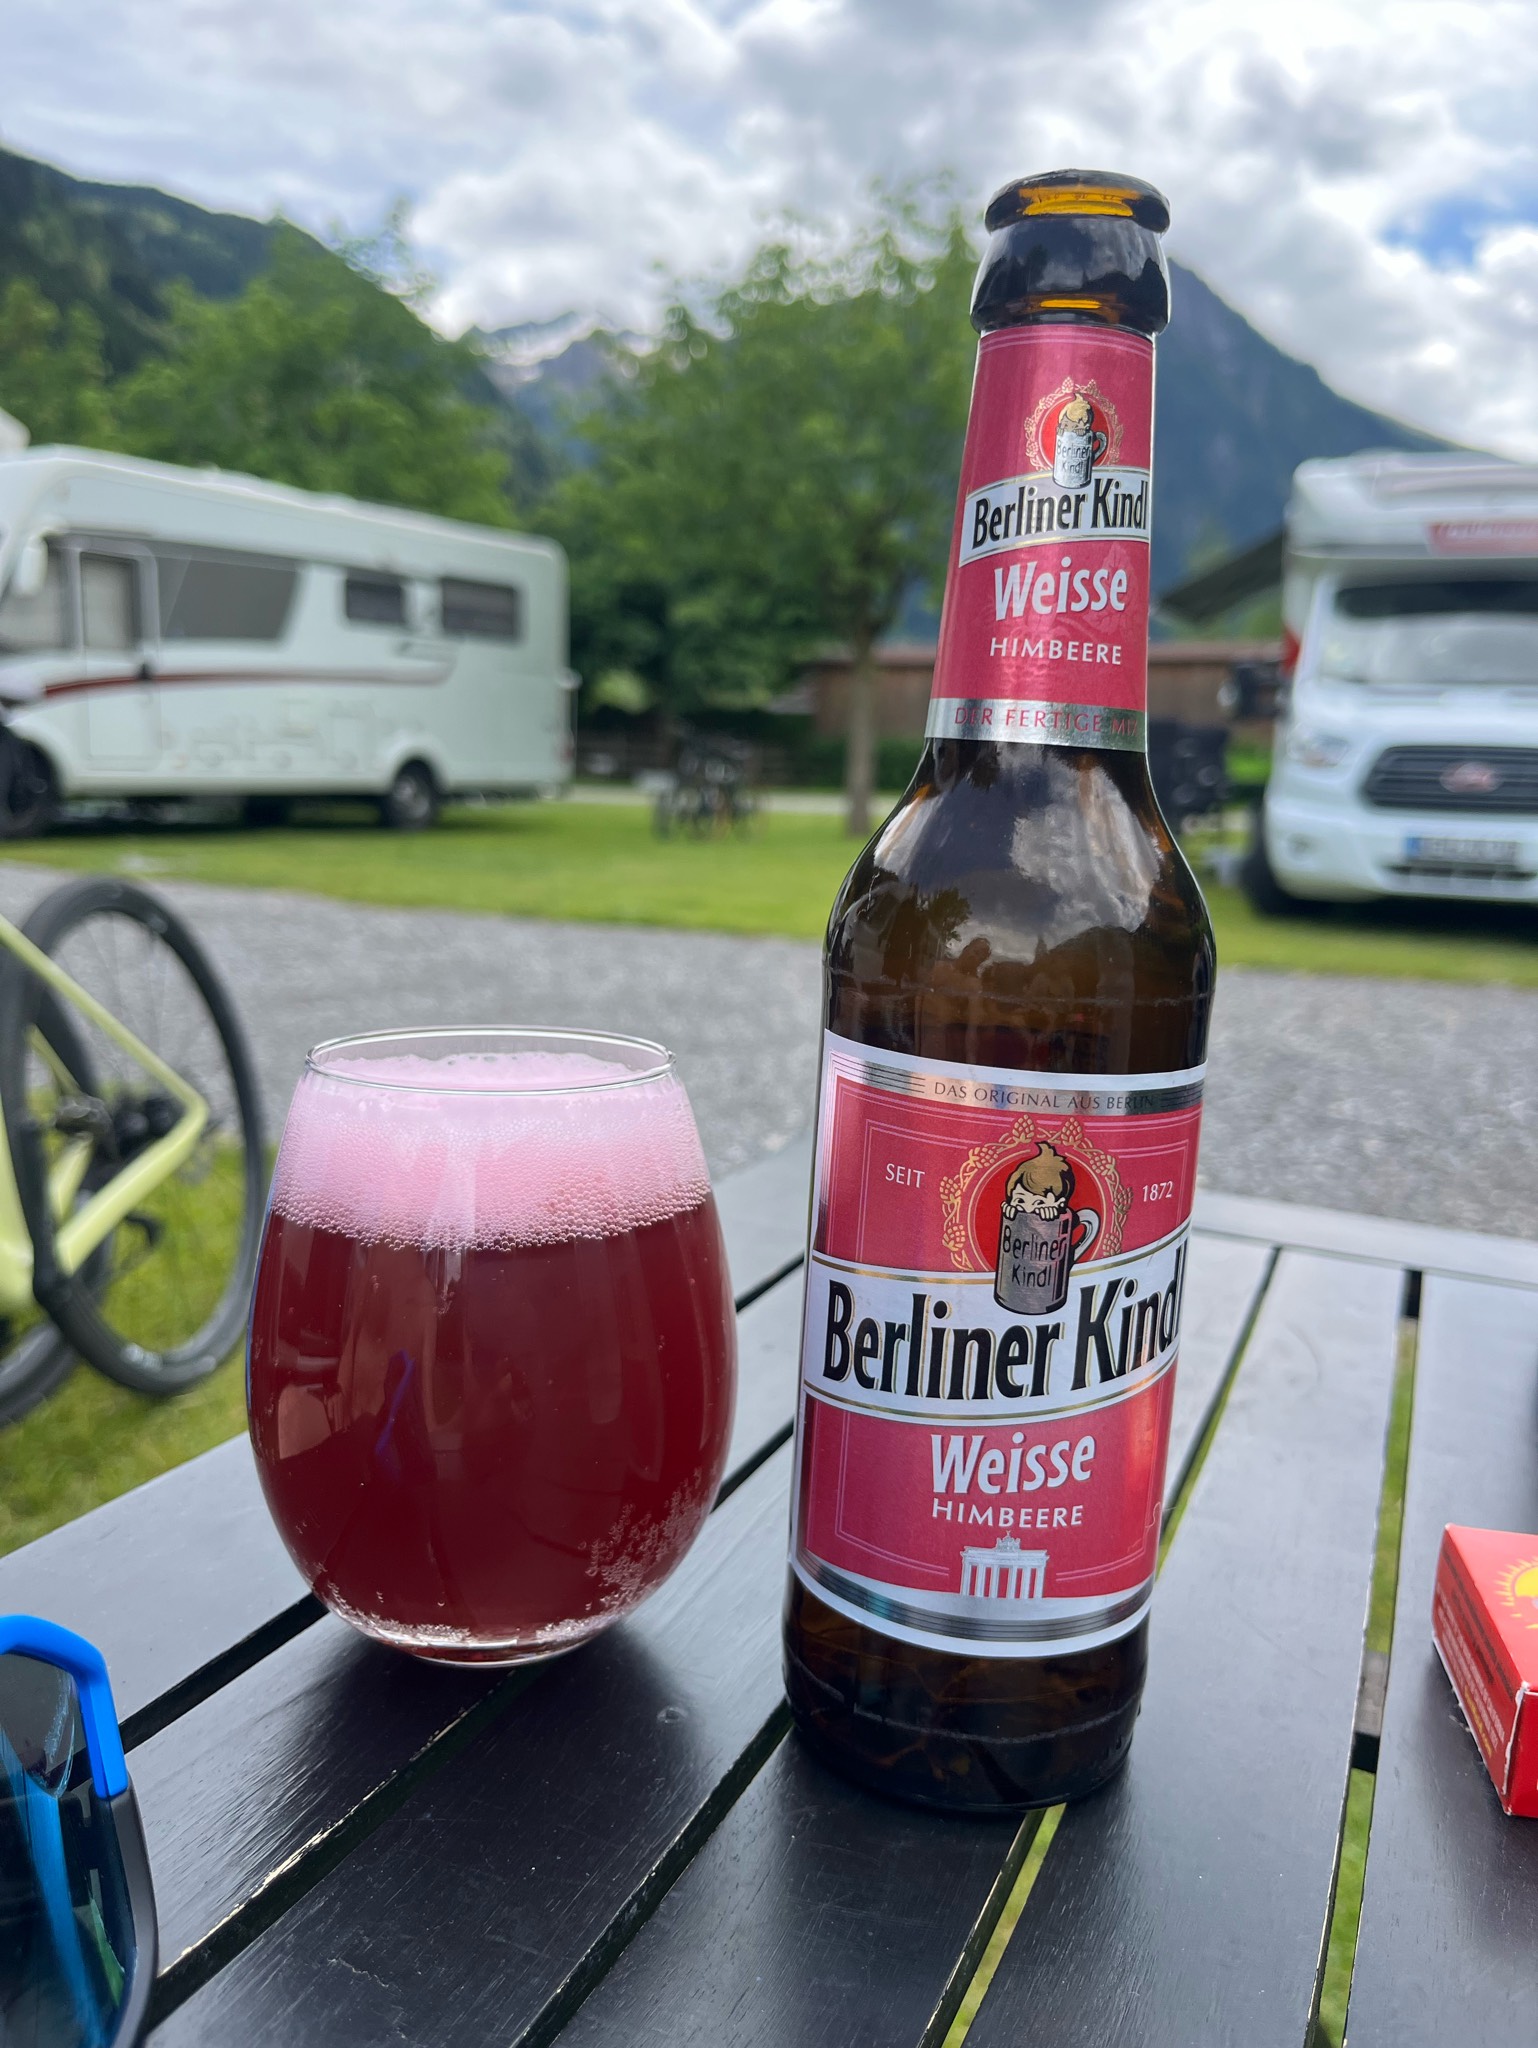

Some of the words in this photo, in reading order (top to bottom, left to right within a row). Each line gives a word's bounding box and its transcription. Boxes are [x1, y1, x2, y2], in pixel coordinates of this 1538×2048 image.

[1056, 439, 1091, 459] Berliner
[1062, 461, 1084, 474] Kindl
[972, 486, 1088, 549] Berliner
[1091, 478, 1148, 530] Kindl
[994, 556, 1129, 622] Weisse
[989, 637, 1122, 666] HIMBEERE
[954, 707, 993, 726] DER
[1005, 708, 1103, 733] FERTIGE
[934, 1081, 968, 1097] DAS
[973, 1087, 1061, 1108] ORIGINAL
[1066, 1095, 1101, 1110] AUS
[1106, 1095, 1154, 1111] BERLIN
[885, 1163, 925, 1188] SEIT
[1142, 1181, 1173, 1202] 1872
[1003, 1223, 1068, 1263] Berliner
[1011, 1263, 1052, 1289] Kindl
[822, 1278, 1065, 1400] Berliner
[931, 1431, 1095, 1495] Weisse
[931, 1498, 1084, 1529] HIMBEERE
